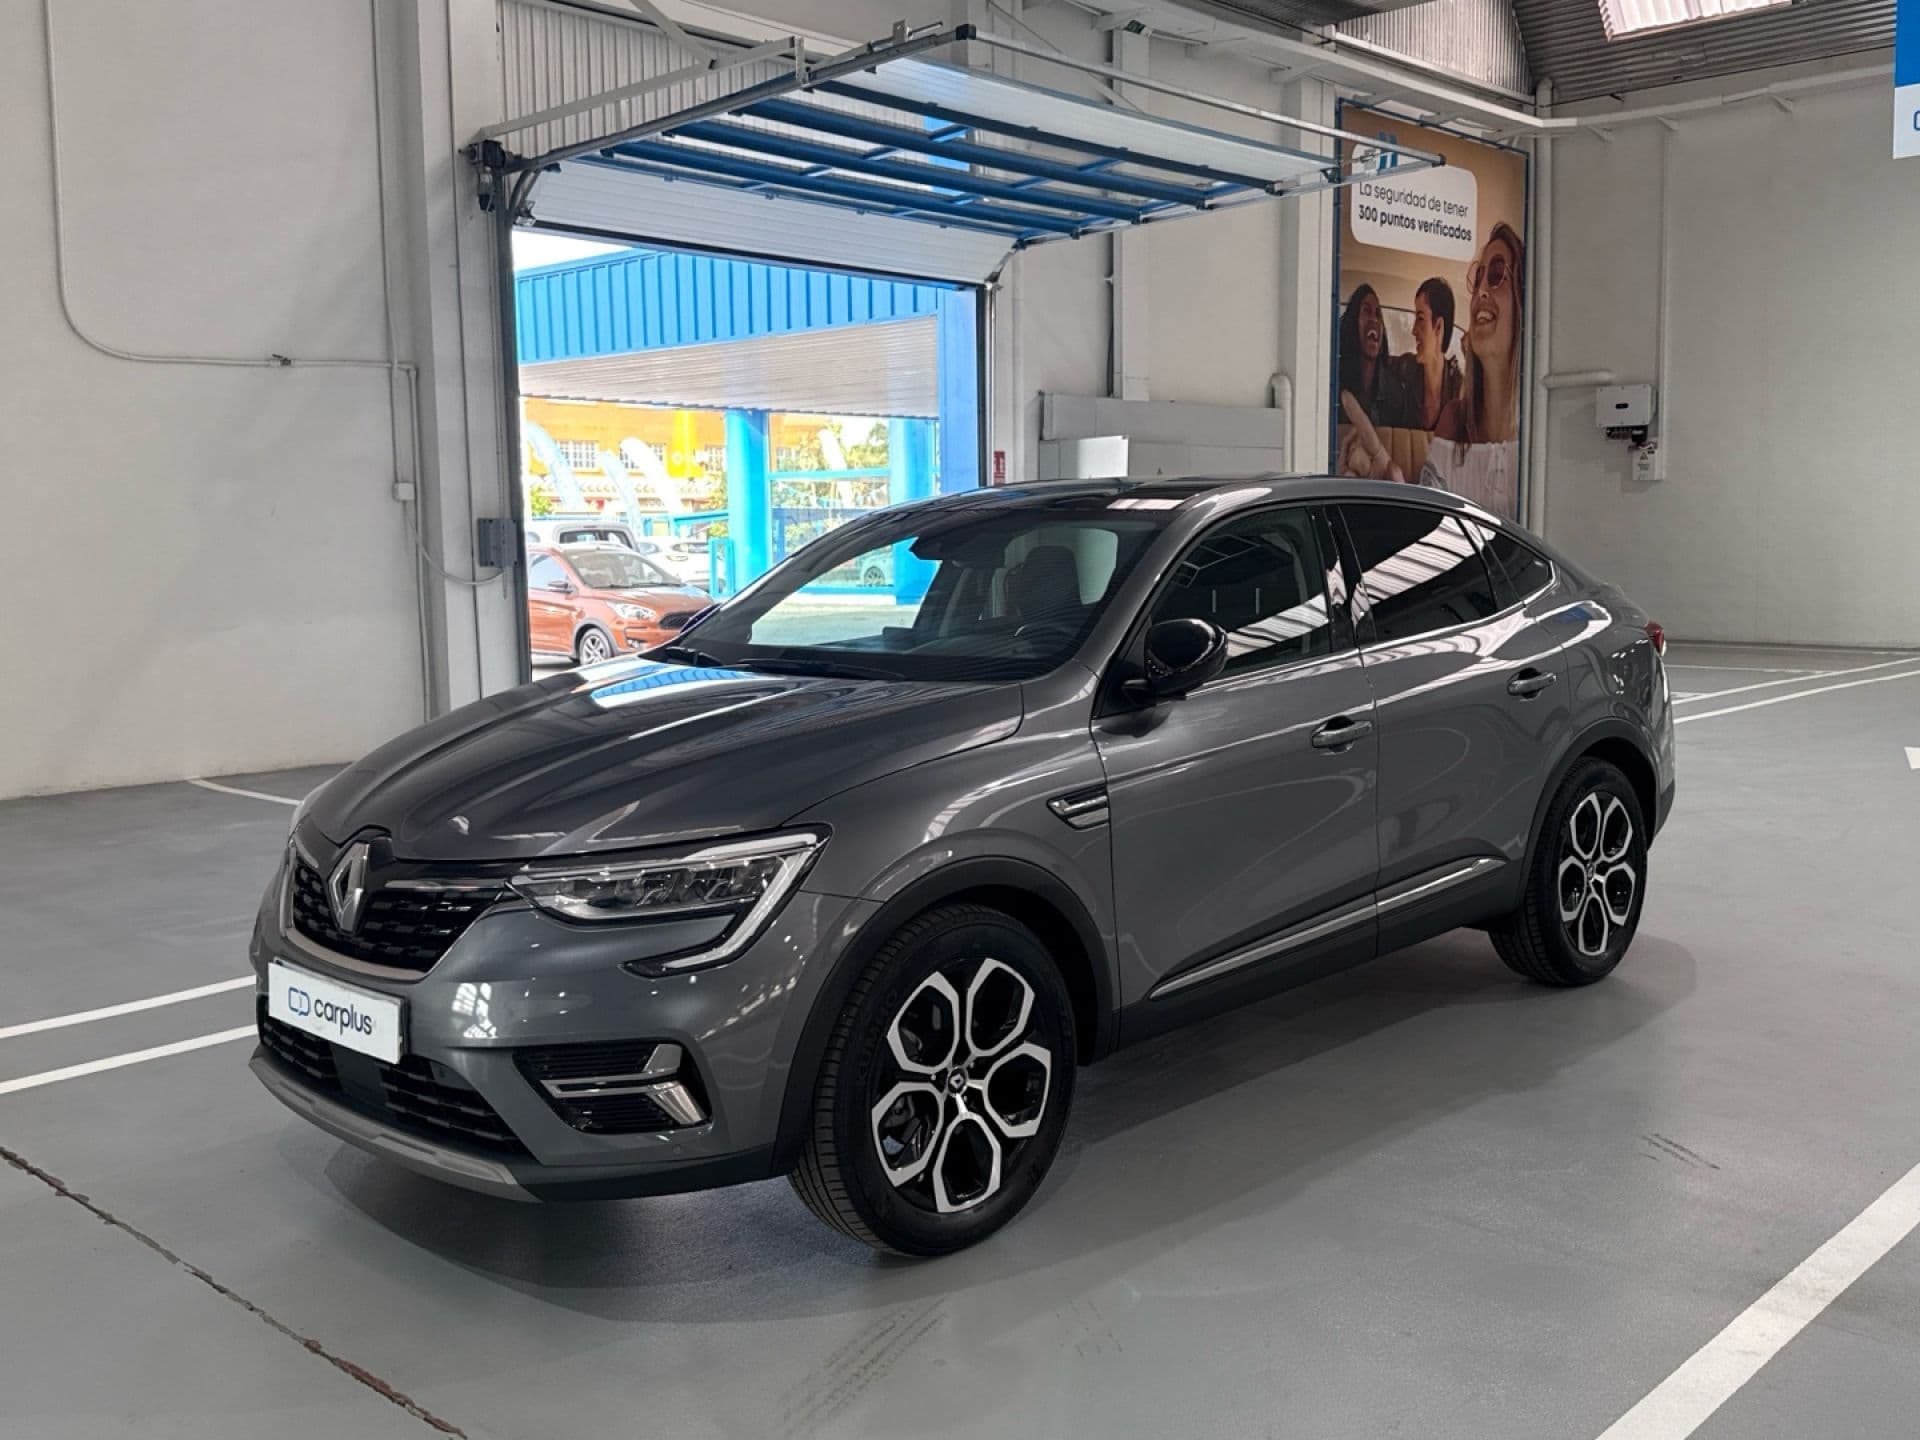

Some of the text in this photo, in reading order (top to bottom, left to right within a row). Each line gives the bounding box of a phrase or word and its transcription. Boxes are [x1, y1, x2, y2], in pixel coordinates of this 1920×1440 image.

[1359, 182, 1469, 217] La seguridad de tener
[1359, 205, 1472, 241] 300 puntos verificados
[314, 999, 373, 1035] carplus
